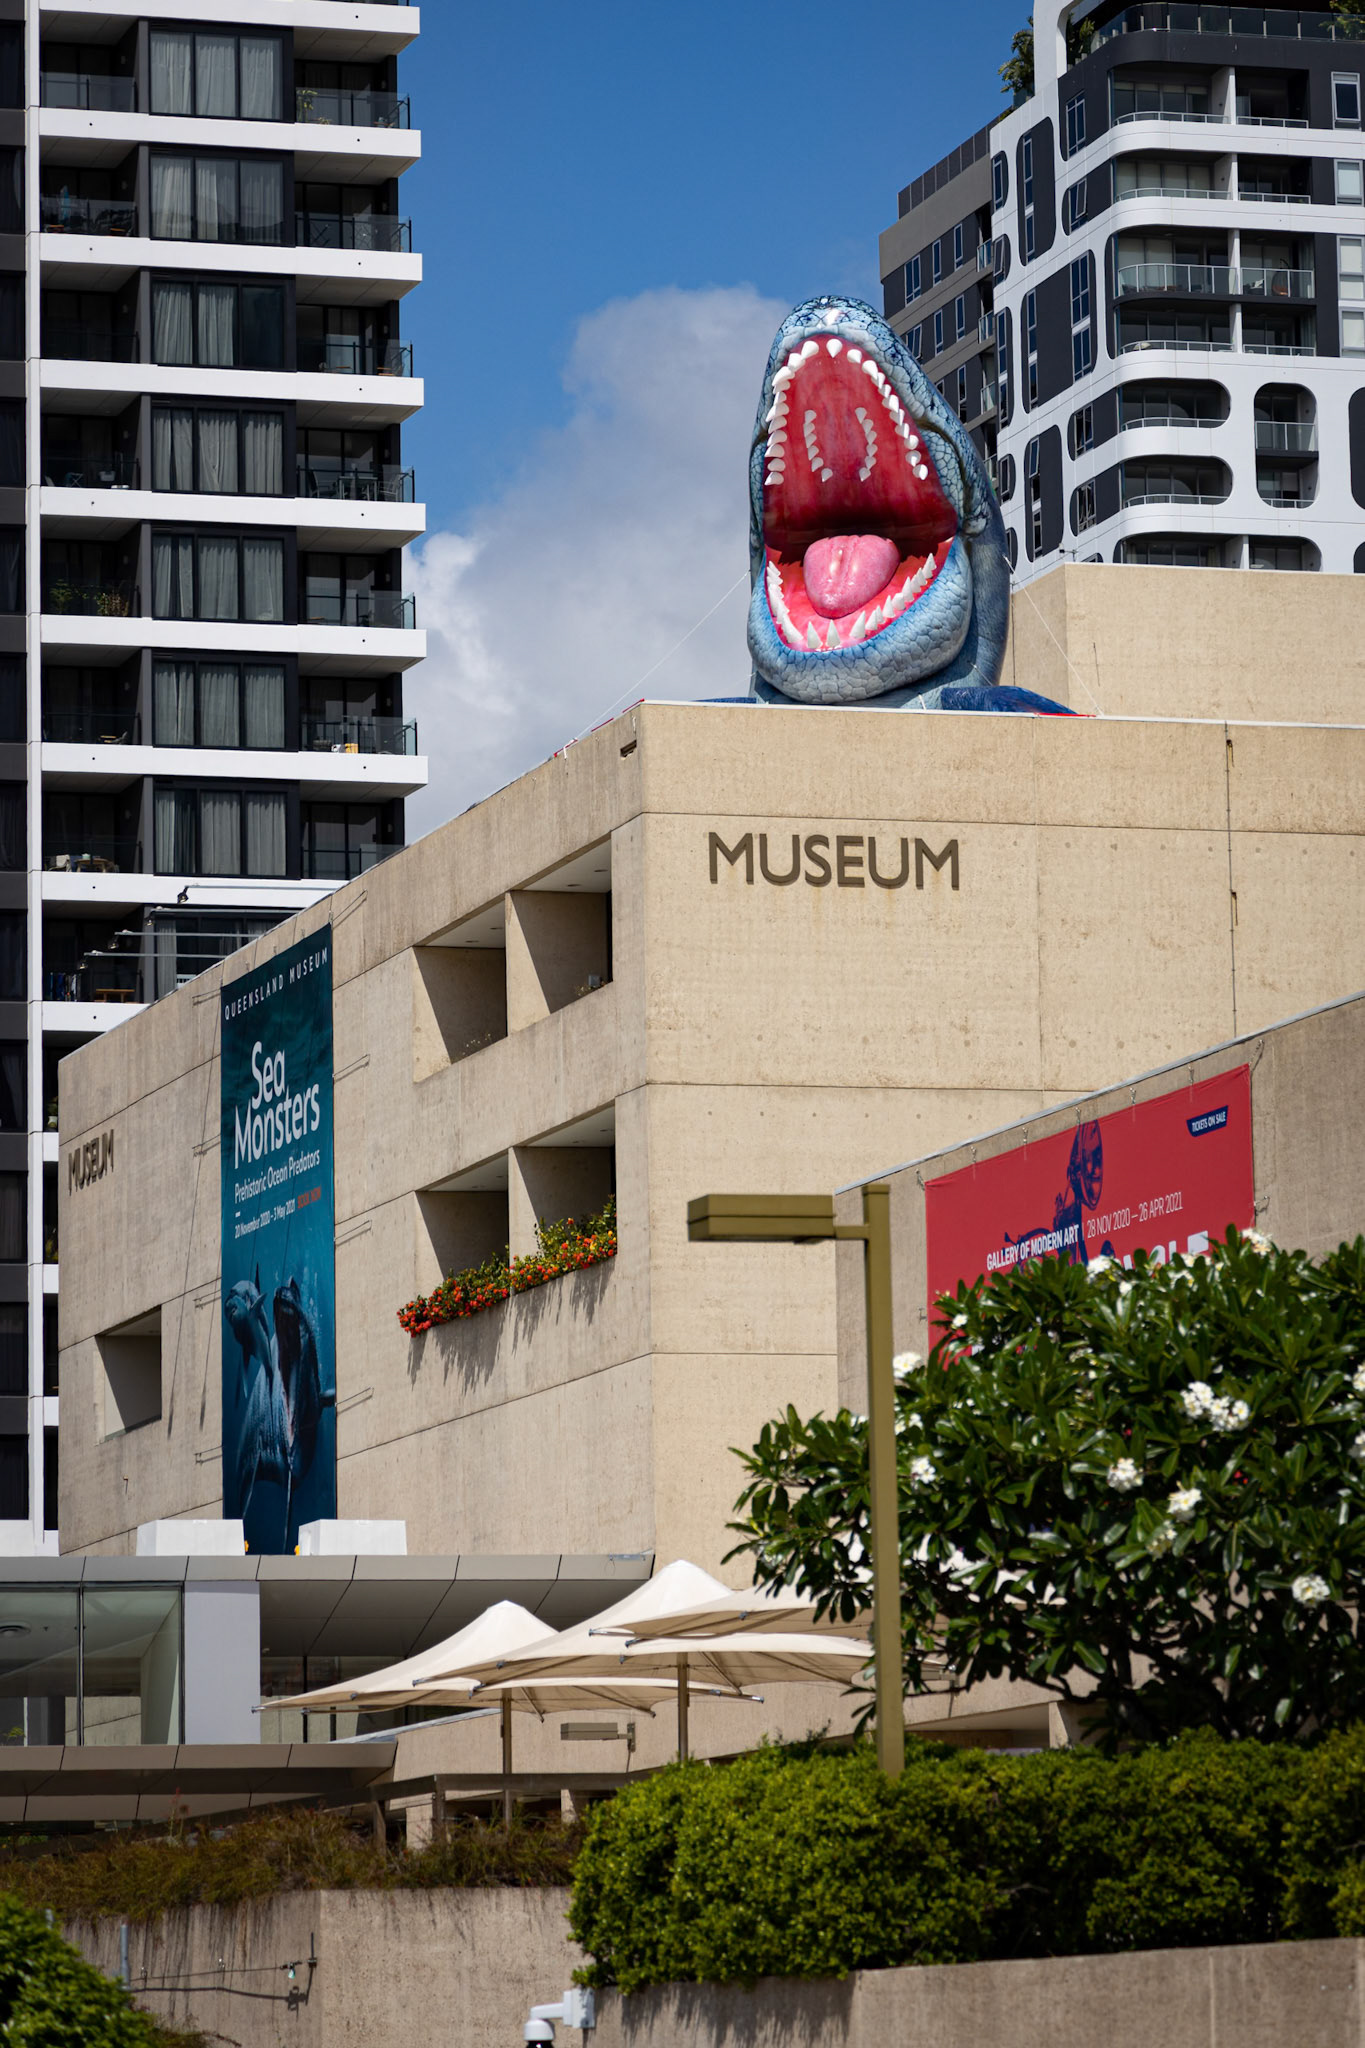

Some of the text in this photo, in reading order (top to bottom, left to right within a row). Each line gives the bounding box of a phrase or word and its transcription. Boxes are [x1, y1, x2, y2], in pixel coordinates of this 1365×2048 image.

[708, 832, 960, 891] MUSEUM
[225, 947, 328, 1020] QUEENSLAND MUSEUM
[251, 1041, 285, 1110] Sea
[234, 1084, 320, 1170] Monsters
[1208, 1115, 1216, 1127] ON
[1215, 1111, 1226, 1124] SALE
[68, 1129, 114, 1196] MUSEUM
[234, 1149, 320, 1204] Prehistoric Ocean Predators
[240, 1216, 260, 1236] November
[277, 1205, 286, 1220] May
[986, 1244, 1020, 1271] GALLERY
[1020, 1240, 1031, 1260] OF
[1031, 1229, 1063, 1257] MODERN
[1063, 1224, 1079, 1247] ART
[1086, 1218, 1096, 1238] 28
[1096, 1213, 1112, 1235] NOV
[1112, 1207, 1131, 1231] 2020
[1138, 1201, 1149, 1222] 26
[1148, 1196, 1165, 1219] APR
[1165, 1191, 1183, 1214] 2021
